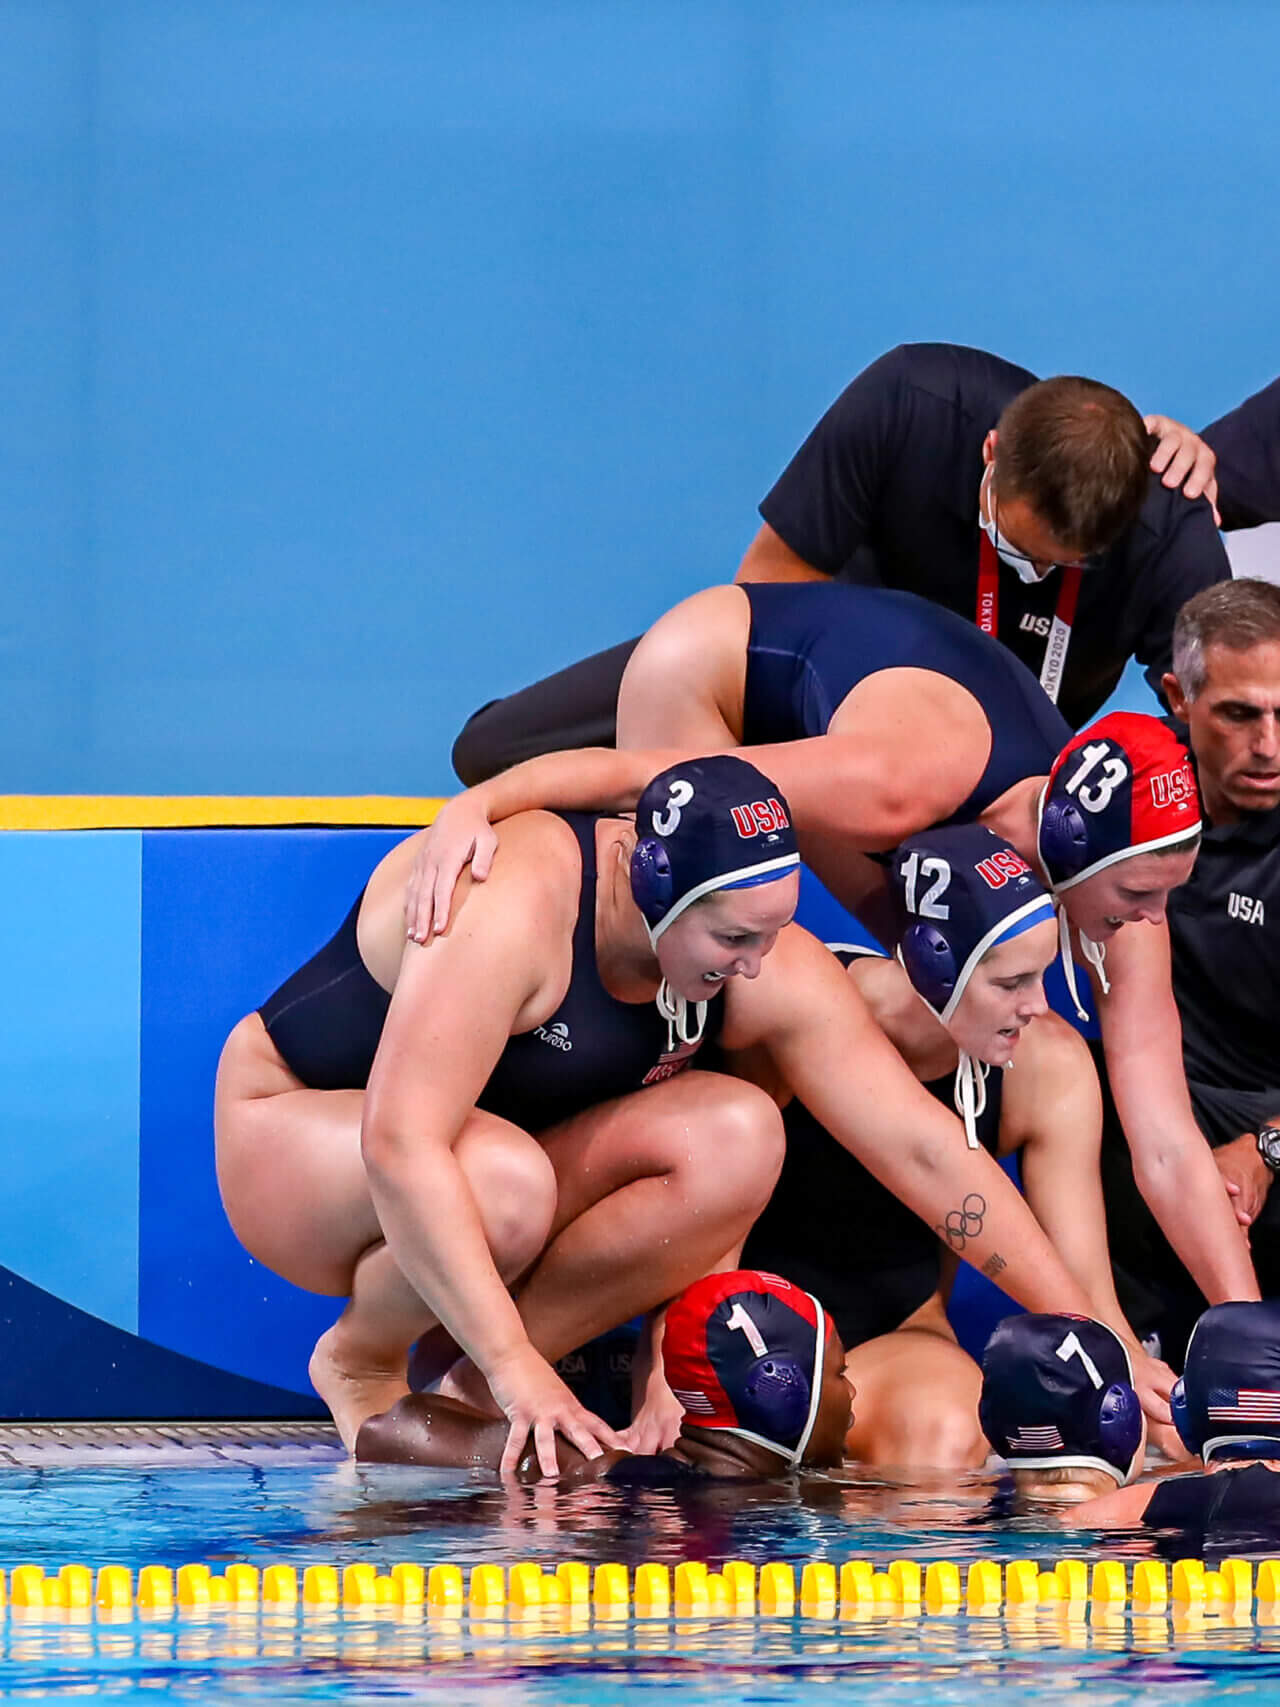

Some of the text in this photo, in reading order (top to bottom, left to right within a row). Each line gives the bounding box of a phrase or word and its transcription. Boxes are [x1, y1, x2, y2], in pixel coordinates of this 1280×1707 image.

[981, 592, 993, 632] TOKYO
[1019, 613, 1051, 637] US
[1044, 628, 1066, 697] OKYO 2020
[1065, 742, 1127, 813] 13
[652, 780, 694, 837] 3
[730, 798, 790, 839] USA
[900, 853, 951, 920] 12
[1227, 892, 1265, 926] USA
[533, 1025, 573, 1052] TURBO
[726, 1303, 768, 1358] 1
[1056, 1331, 1104, 1390] 7
